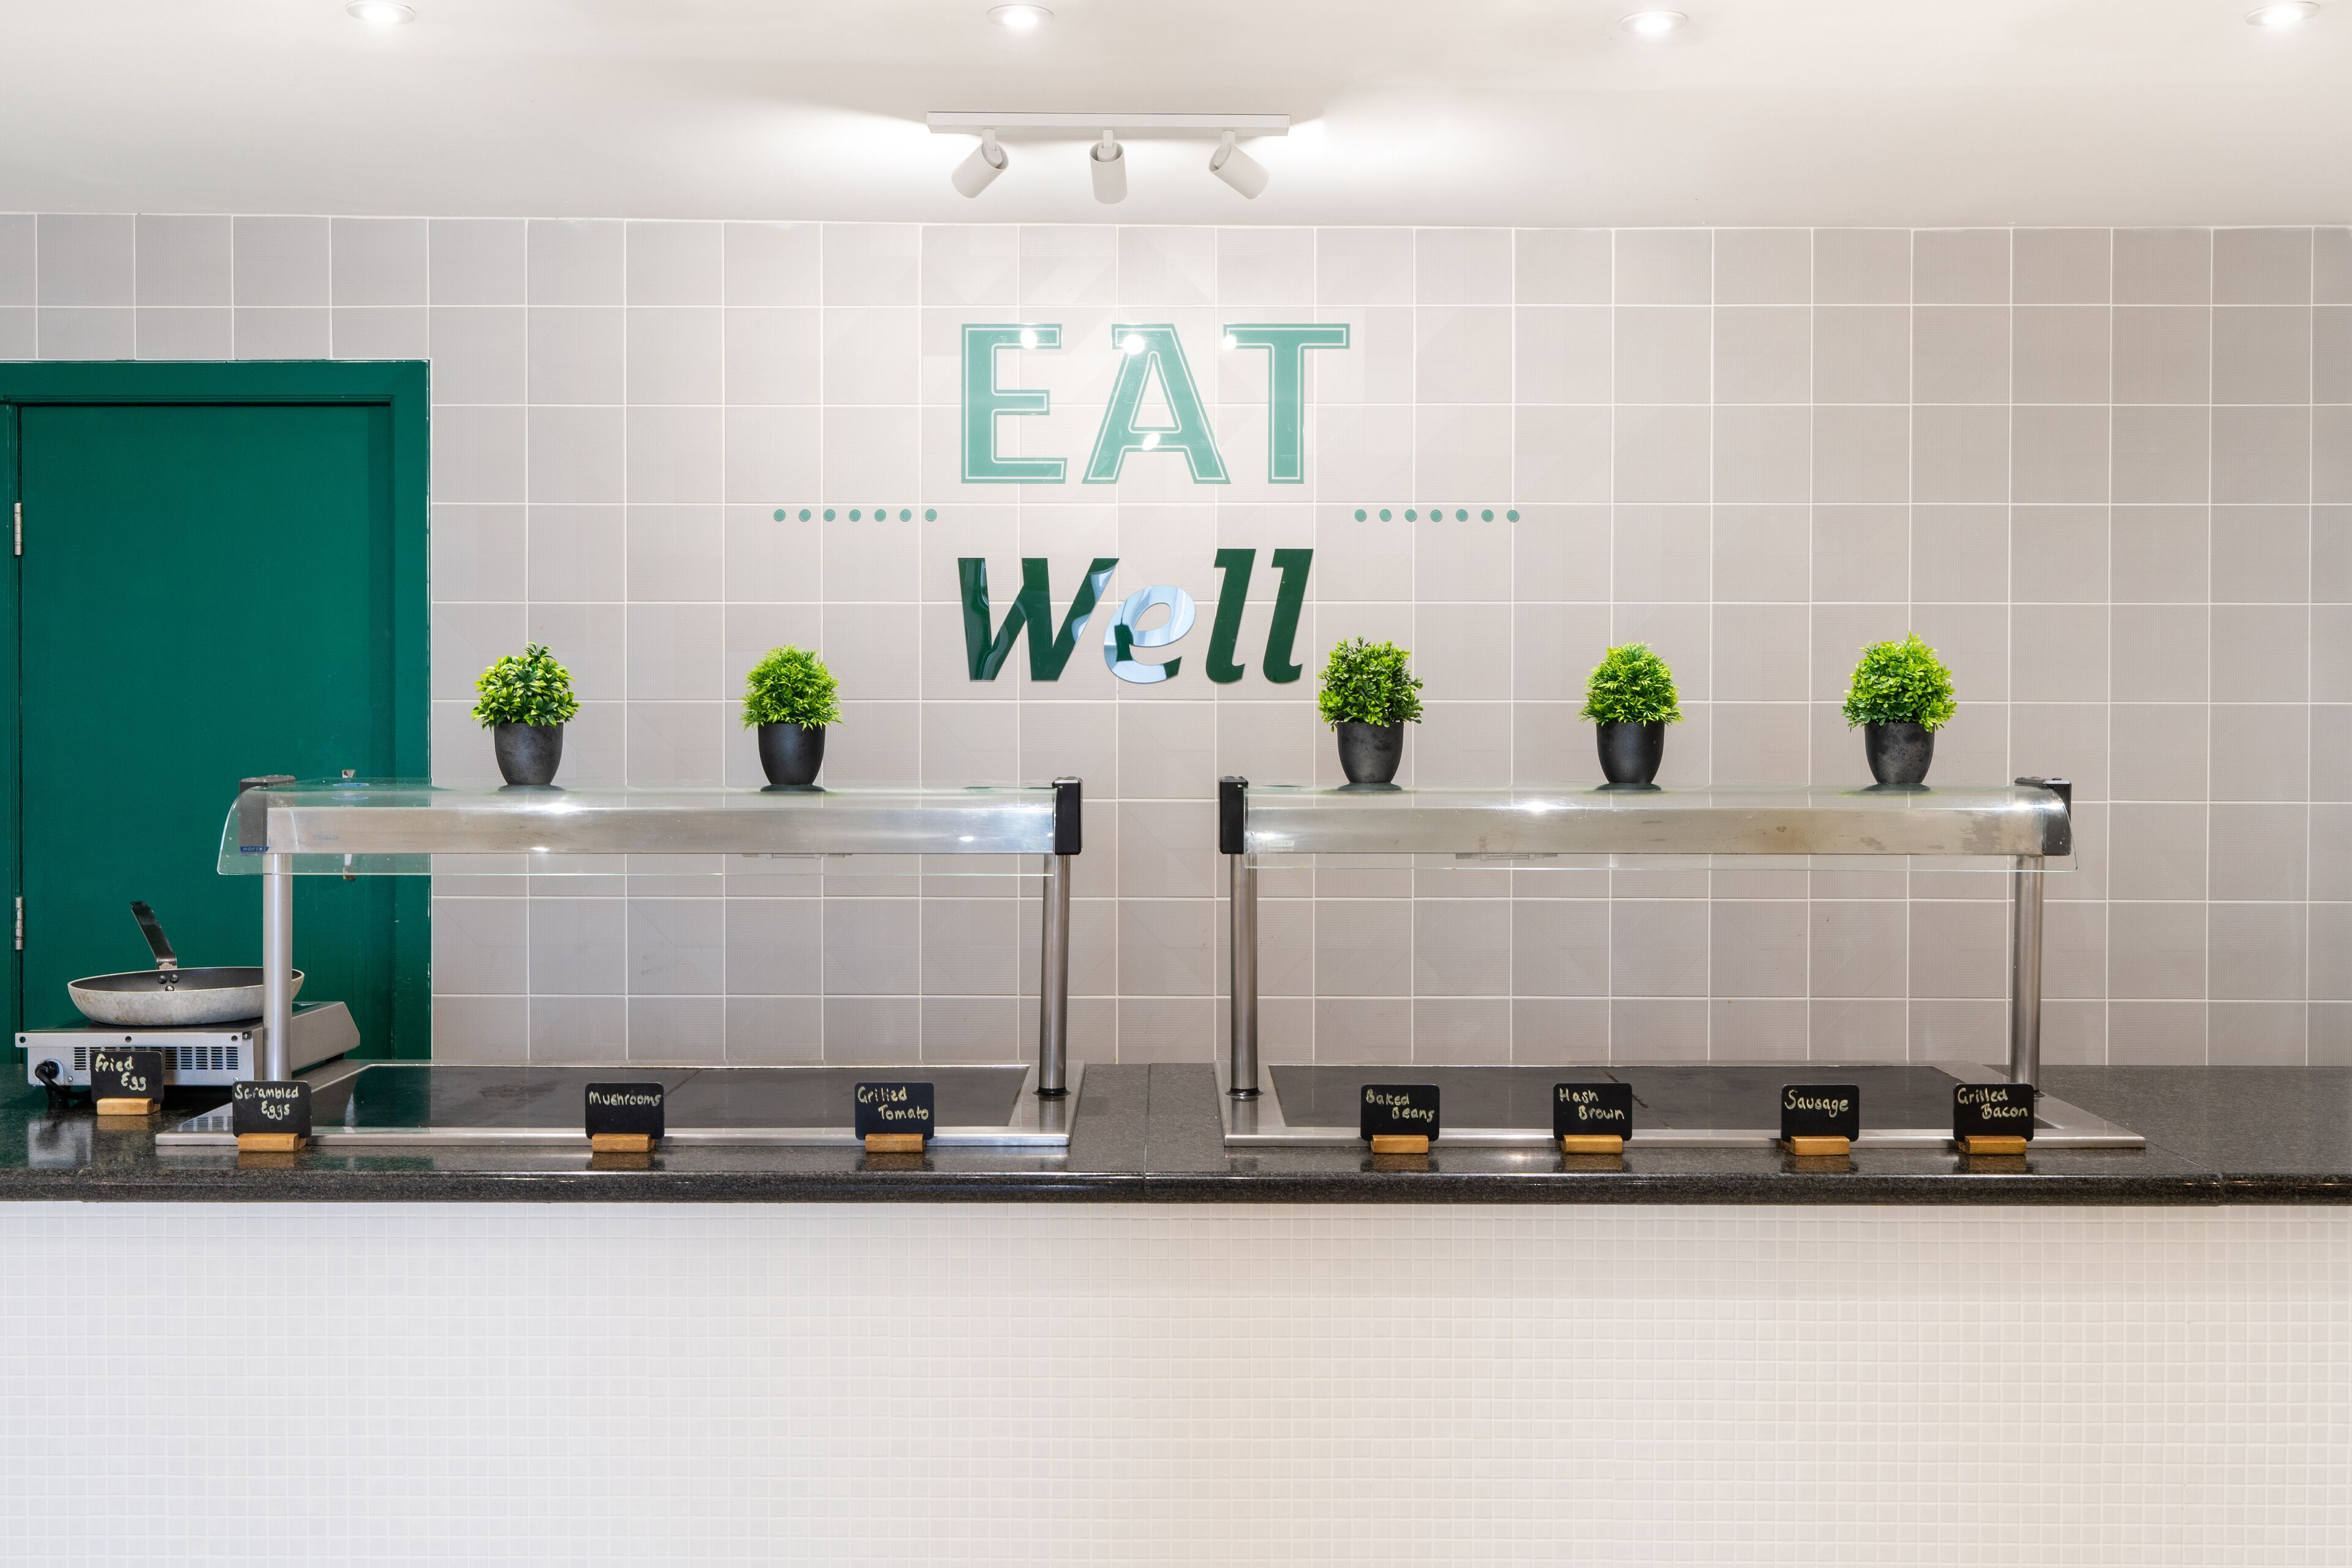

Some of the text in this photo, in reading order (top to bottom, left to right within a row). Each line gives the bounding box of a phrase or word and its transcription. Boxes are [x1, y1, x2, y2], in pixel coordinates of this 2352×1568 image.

[961, 324, 1350, 484] EAT
[957, 549, 1313, 684] Well
[96, 1053, 134, 1072] Fried
[121, 1071, 146, 1091] Egg
[235, 1084, 299, 1100] Scrambled
[589, 1091, 662, 1107] Mushrooms
[1365, 1089, 1410, 1106] Baked
[1559, 1088, 1599, 1104] Hash
[1958, 1087, 2008, 1104] Grilled
[261, 1100, 290, 1120] Eggs
[878, 1104, 929, 1120] Tomato
[1578, 1104, 1625, 1120] Brown
[1784, 1090, 1849, 1118] Sausage
[1980, 1103, 2029, 1120] Bacon
[1392, 1106, 1435, 1123] Beans
